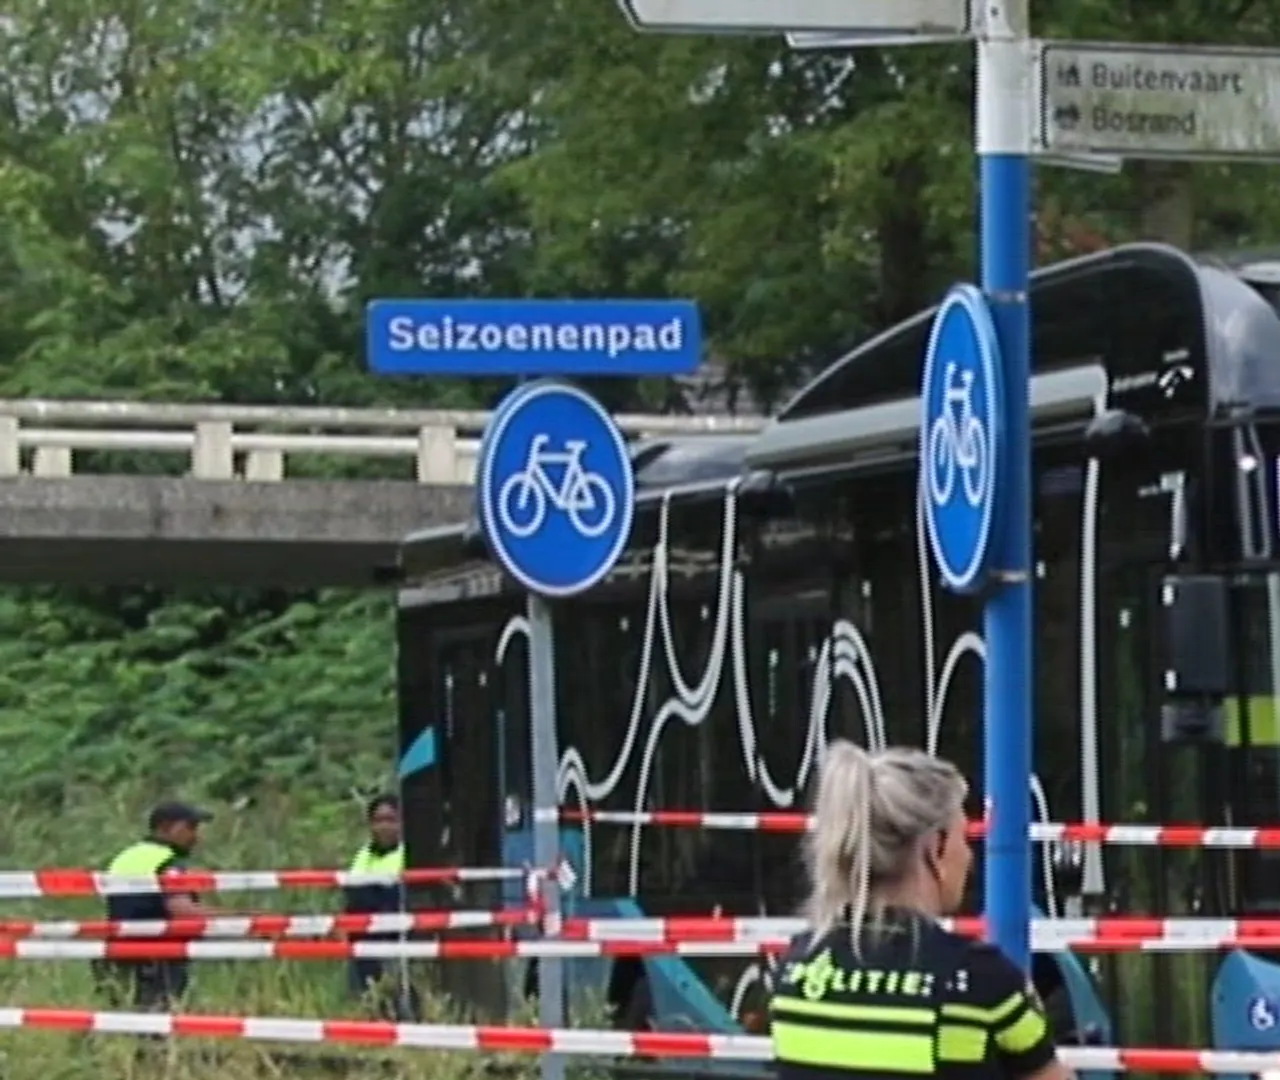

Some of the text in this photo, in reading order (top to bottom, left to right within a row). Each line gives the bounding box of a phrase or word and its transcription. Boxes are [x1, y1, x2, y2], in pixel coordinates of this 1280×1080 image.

[1092, 62, 1243, 94] Buitenvaart
[1092, 106, 1196, 135] Bosrand
[388, 315, 682, 358] Seizoenenpad
